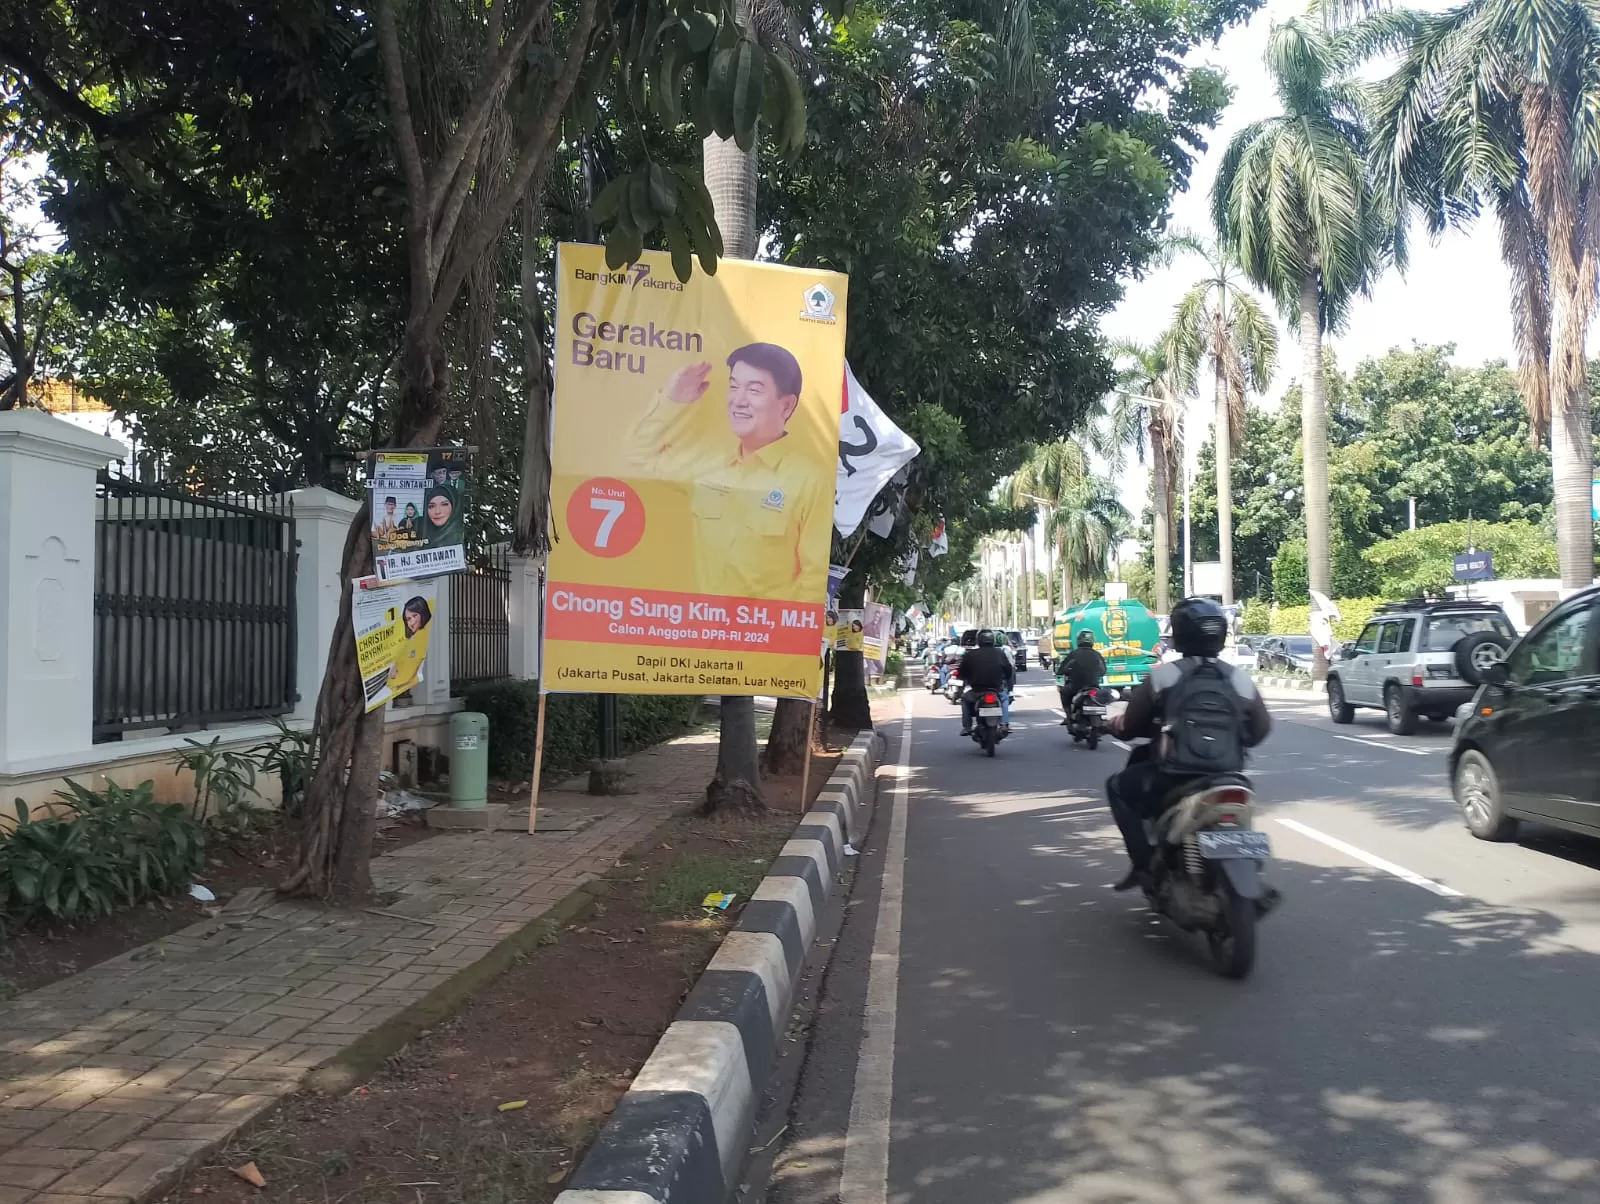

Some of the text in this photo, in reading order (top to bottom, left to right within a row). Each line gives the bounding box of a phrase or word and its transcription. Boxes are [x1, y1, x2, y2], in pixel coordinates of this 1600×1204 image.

[571, 312, 703, 353] Gerakan
[572, 340, 645, 375] Baru
[399, 479, 433, 489] SINTAWATI
[591, 487, 605, 495] No.
[590, 497, 625, 548] 7
[415, 549, 456, 565] SINTAWATI
[552, 590, 819, 629] Chong Sung Kim, S.H., M.H.
[359, 625, 395, 652] CHRISTINA
[608, 622, 769, 643] Calon Anggota DPR-RI 2024
[637, 655, 743, 671] Dapil DKI Jakarta II
[557, 666, 807, 690] (Jakarta Pusat, Jakarta Selatan, Luar Negeri)
